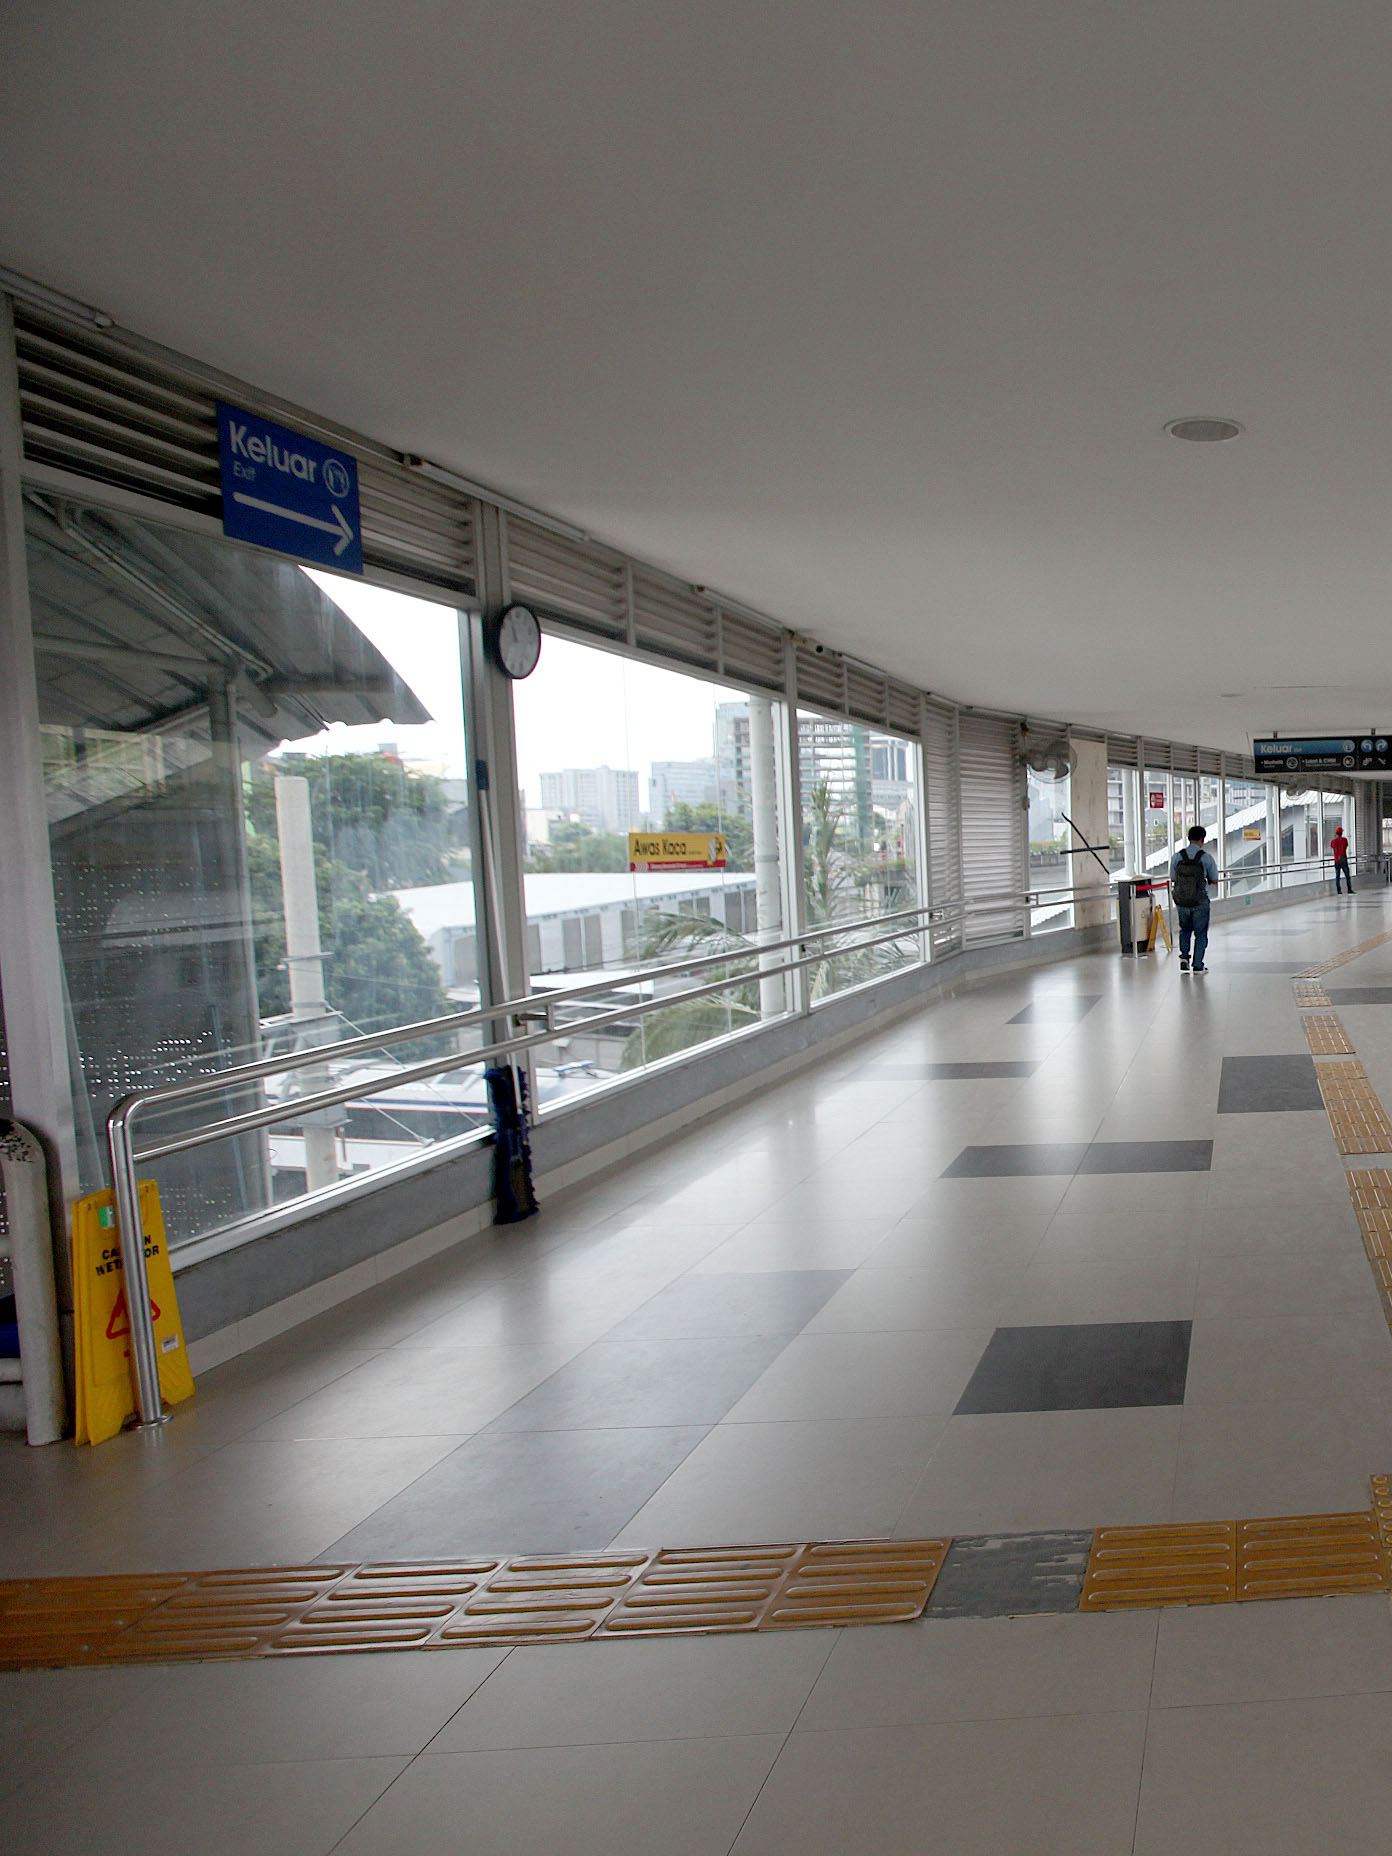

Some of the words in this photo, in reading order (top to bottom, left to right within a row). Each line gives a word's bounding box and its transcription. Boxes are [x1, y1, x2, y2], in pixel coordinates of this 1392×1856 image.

[228, 420, 318, 484] Keluar
[232, 460, 257, 482] Exit
[1260, 743, 1292, 754] Keluar
[633, 838, 660, 856] Awas
[661, 838, 687, 856] Kaca
